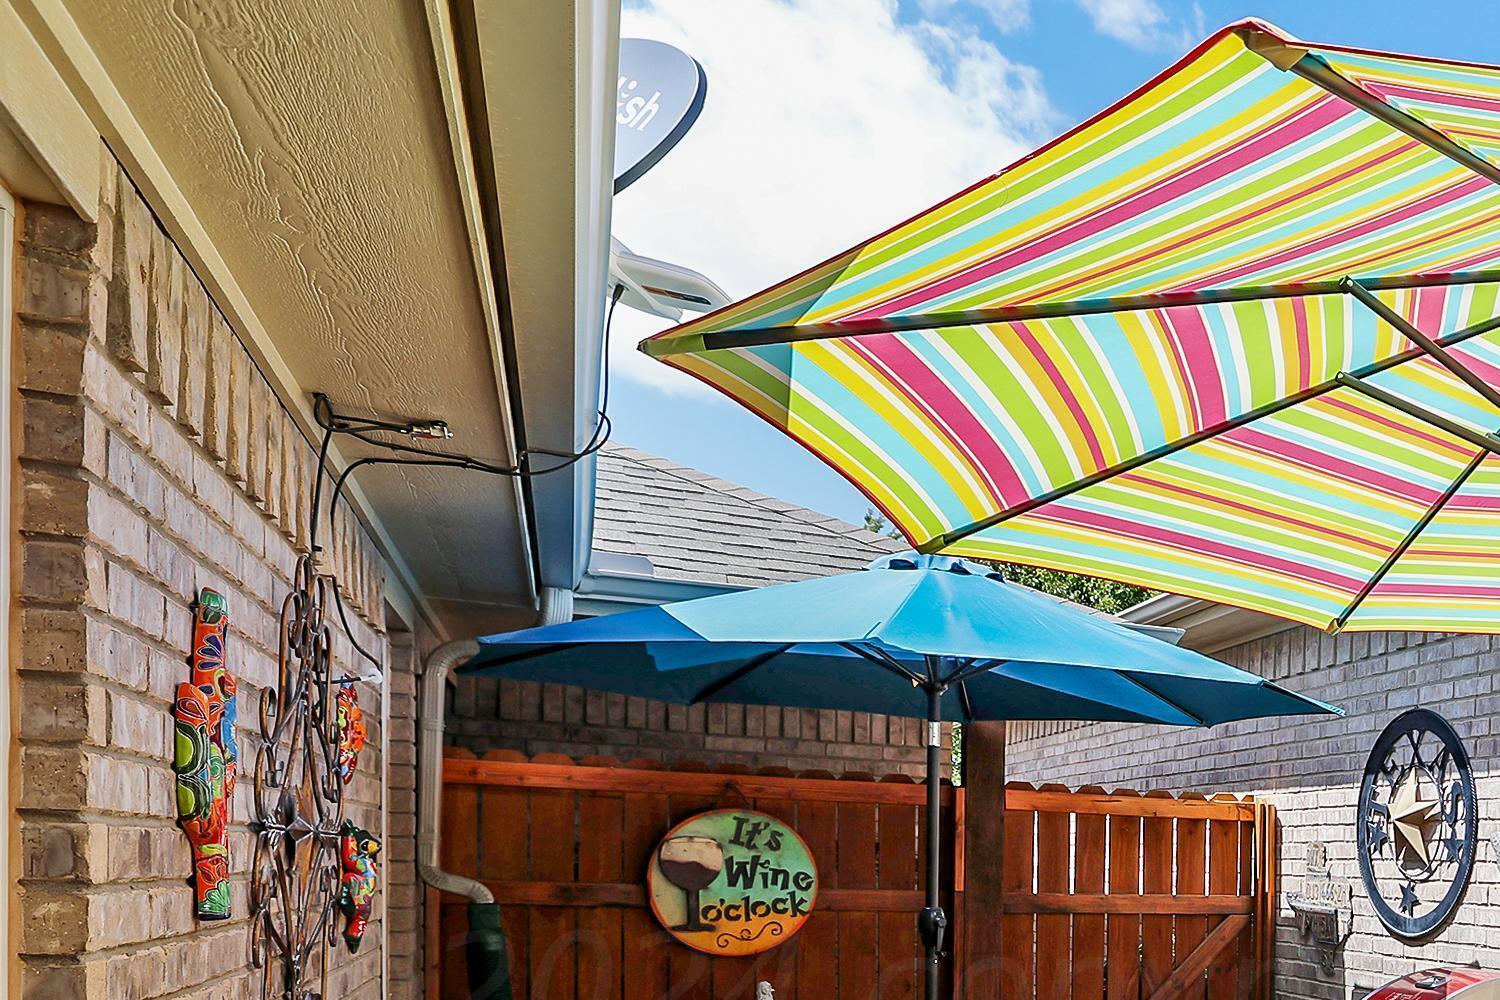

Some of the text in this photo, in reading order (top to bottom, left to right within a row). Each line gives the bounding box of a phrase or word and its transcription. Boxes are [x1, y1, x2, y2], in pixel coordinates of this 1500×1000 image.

[617, 75, 661, 131] ish
[728, 816, 784, 852] It's
[724, 854, 814, 892] Wine
[701, 891, 810, 922] o'clock
